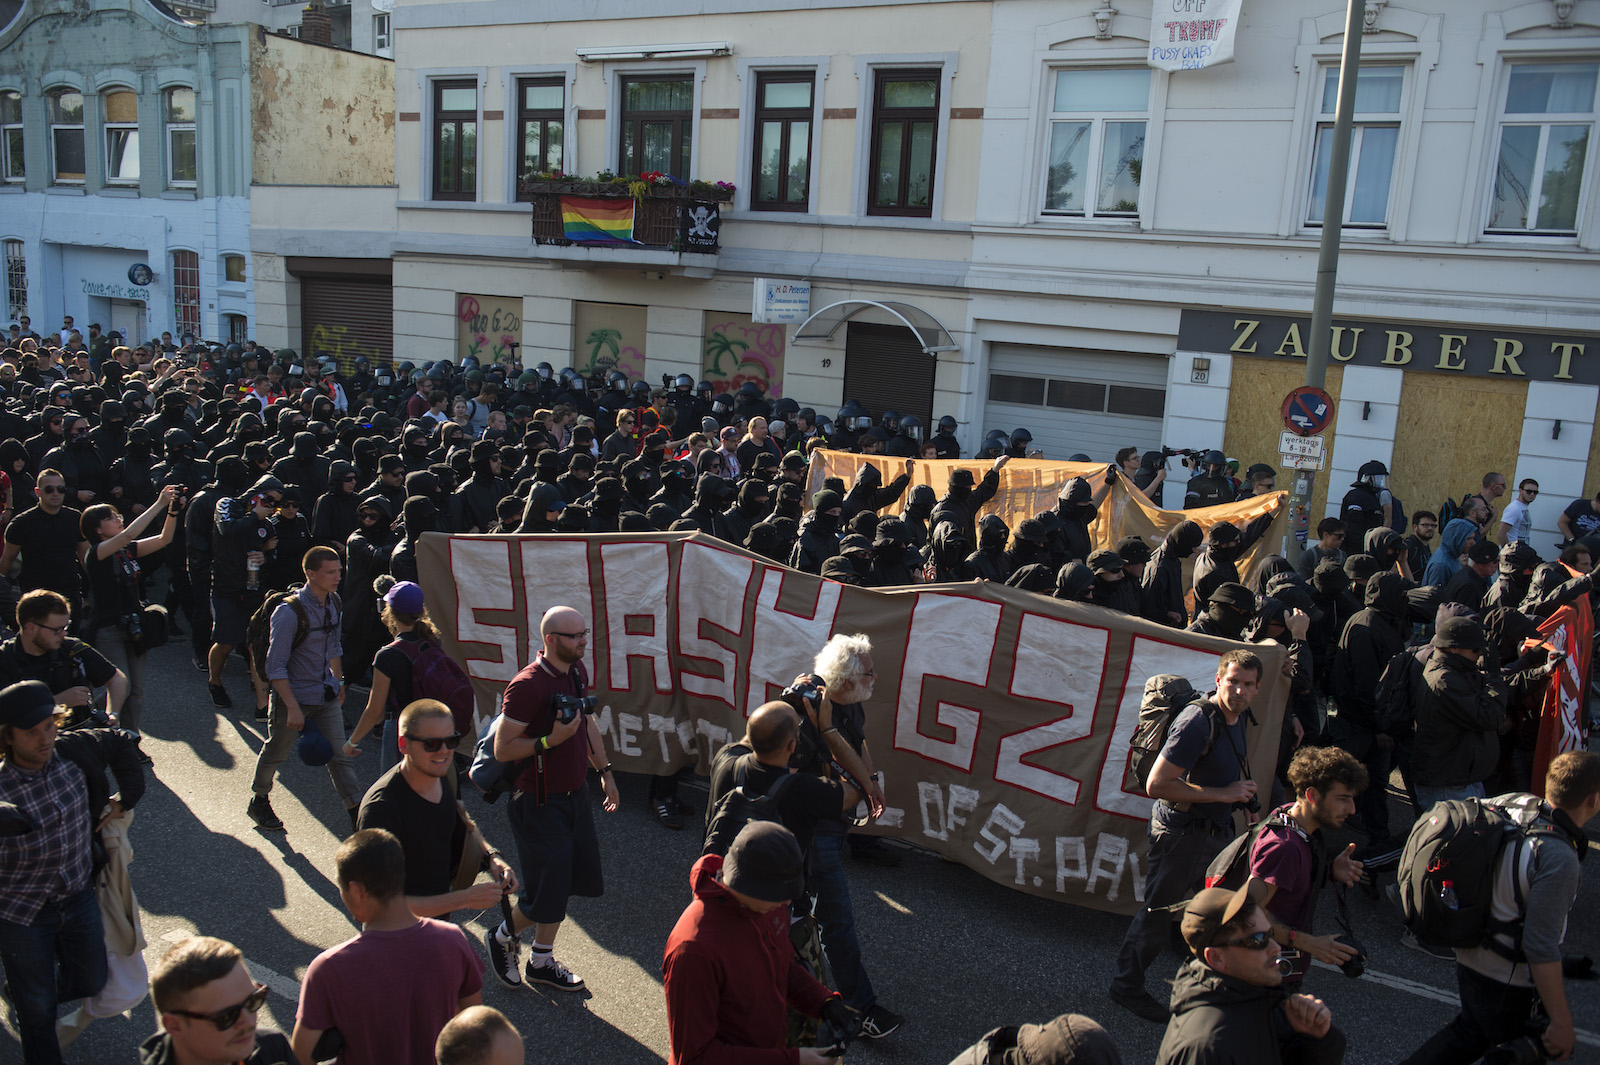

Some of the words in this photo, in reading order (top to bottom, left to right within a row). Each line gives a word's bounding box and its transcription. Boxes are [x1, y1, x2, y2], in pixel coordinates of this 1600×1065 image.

[1164, 18, 1227, 42] TRUMP
[1152, 46, 1181, 61] PUSSY
[1181, 44, 1213, 60] GRABS
[788, 286, 810, 294] Petersen
[821, 358, 831, 368] 19
[1194, 371, 1206, 381] 20
[1284, 437, 1319, 448] werktags
[916, 781, 980, 843] OF
[973, 802, 1044, 887] ST.
[1055, 831, 1147, 903] PAU
